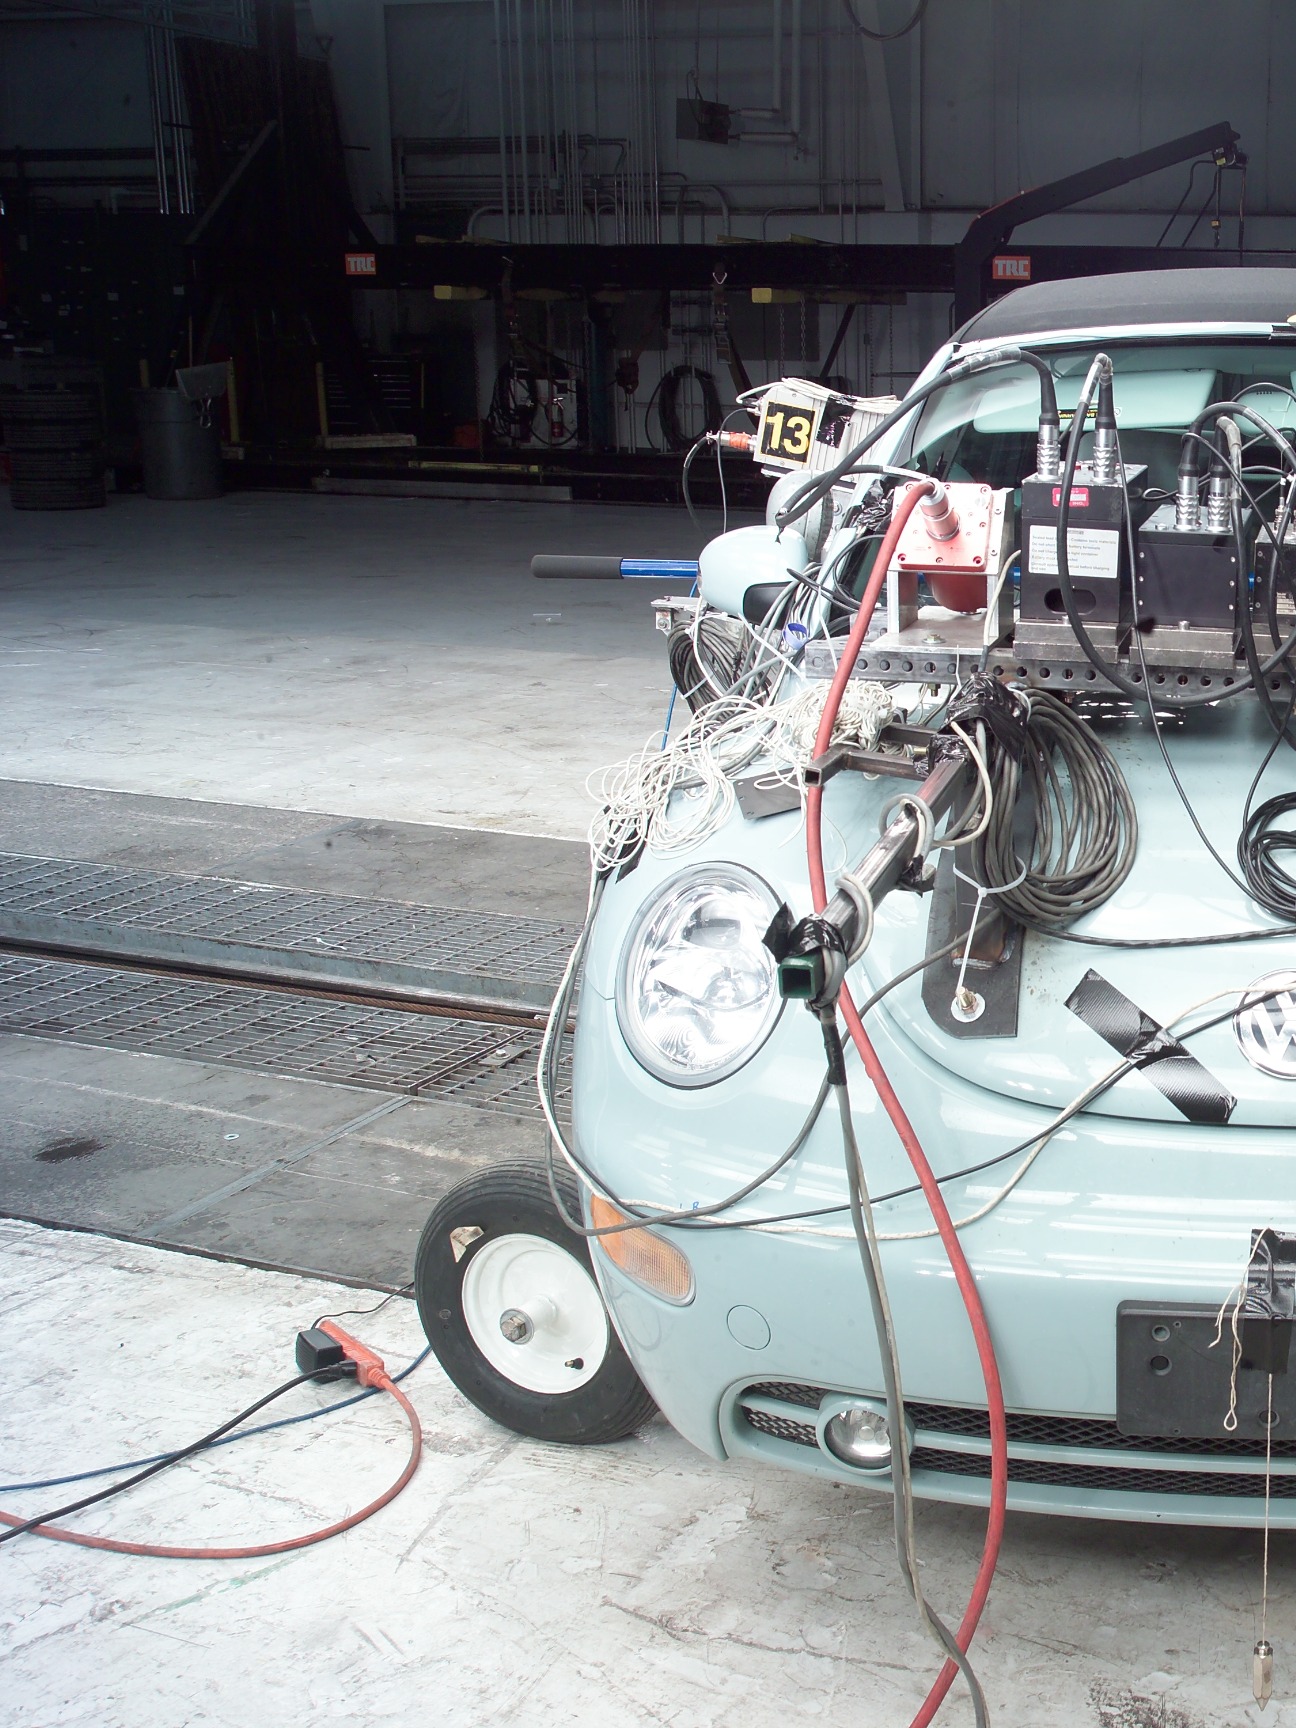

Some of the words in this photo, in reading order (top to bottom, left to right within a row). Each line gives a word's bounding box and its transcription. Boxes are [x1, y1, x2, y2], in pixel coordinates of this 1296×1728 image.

[347, 257, 376, 272] TRC
[994, 260, 1029, 276] TRC
[766, 412, 811, 455] 13
